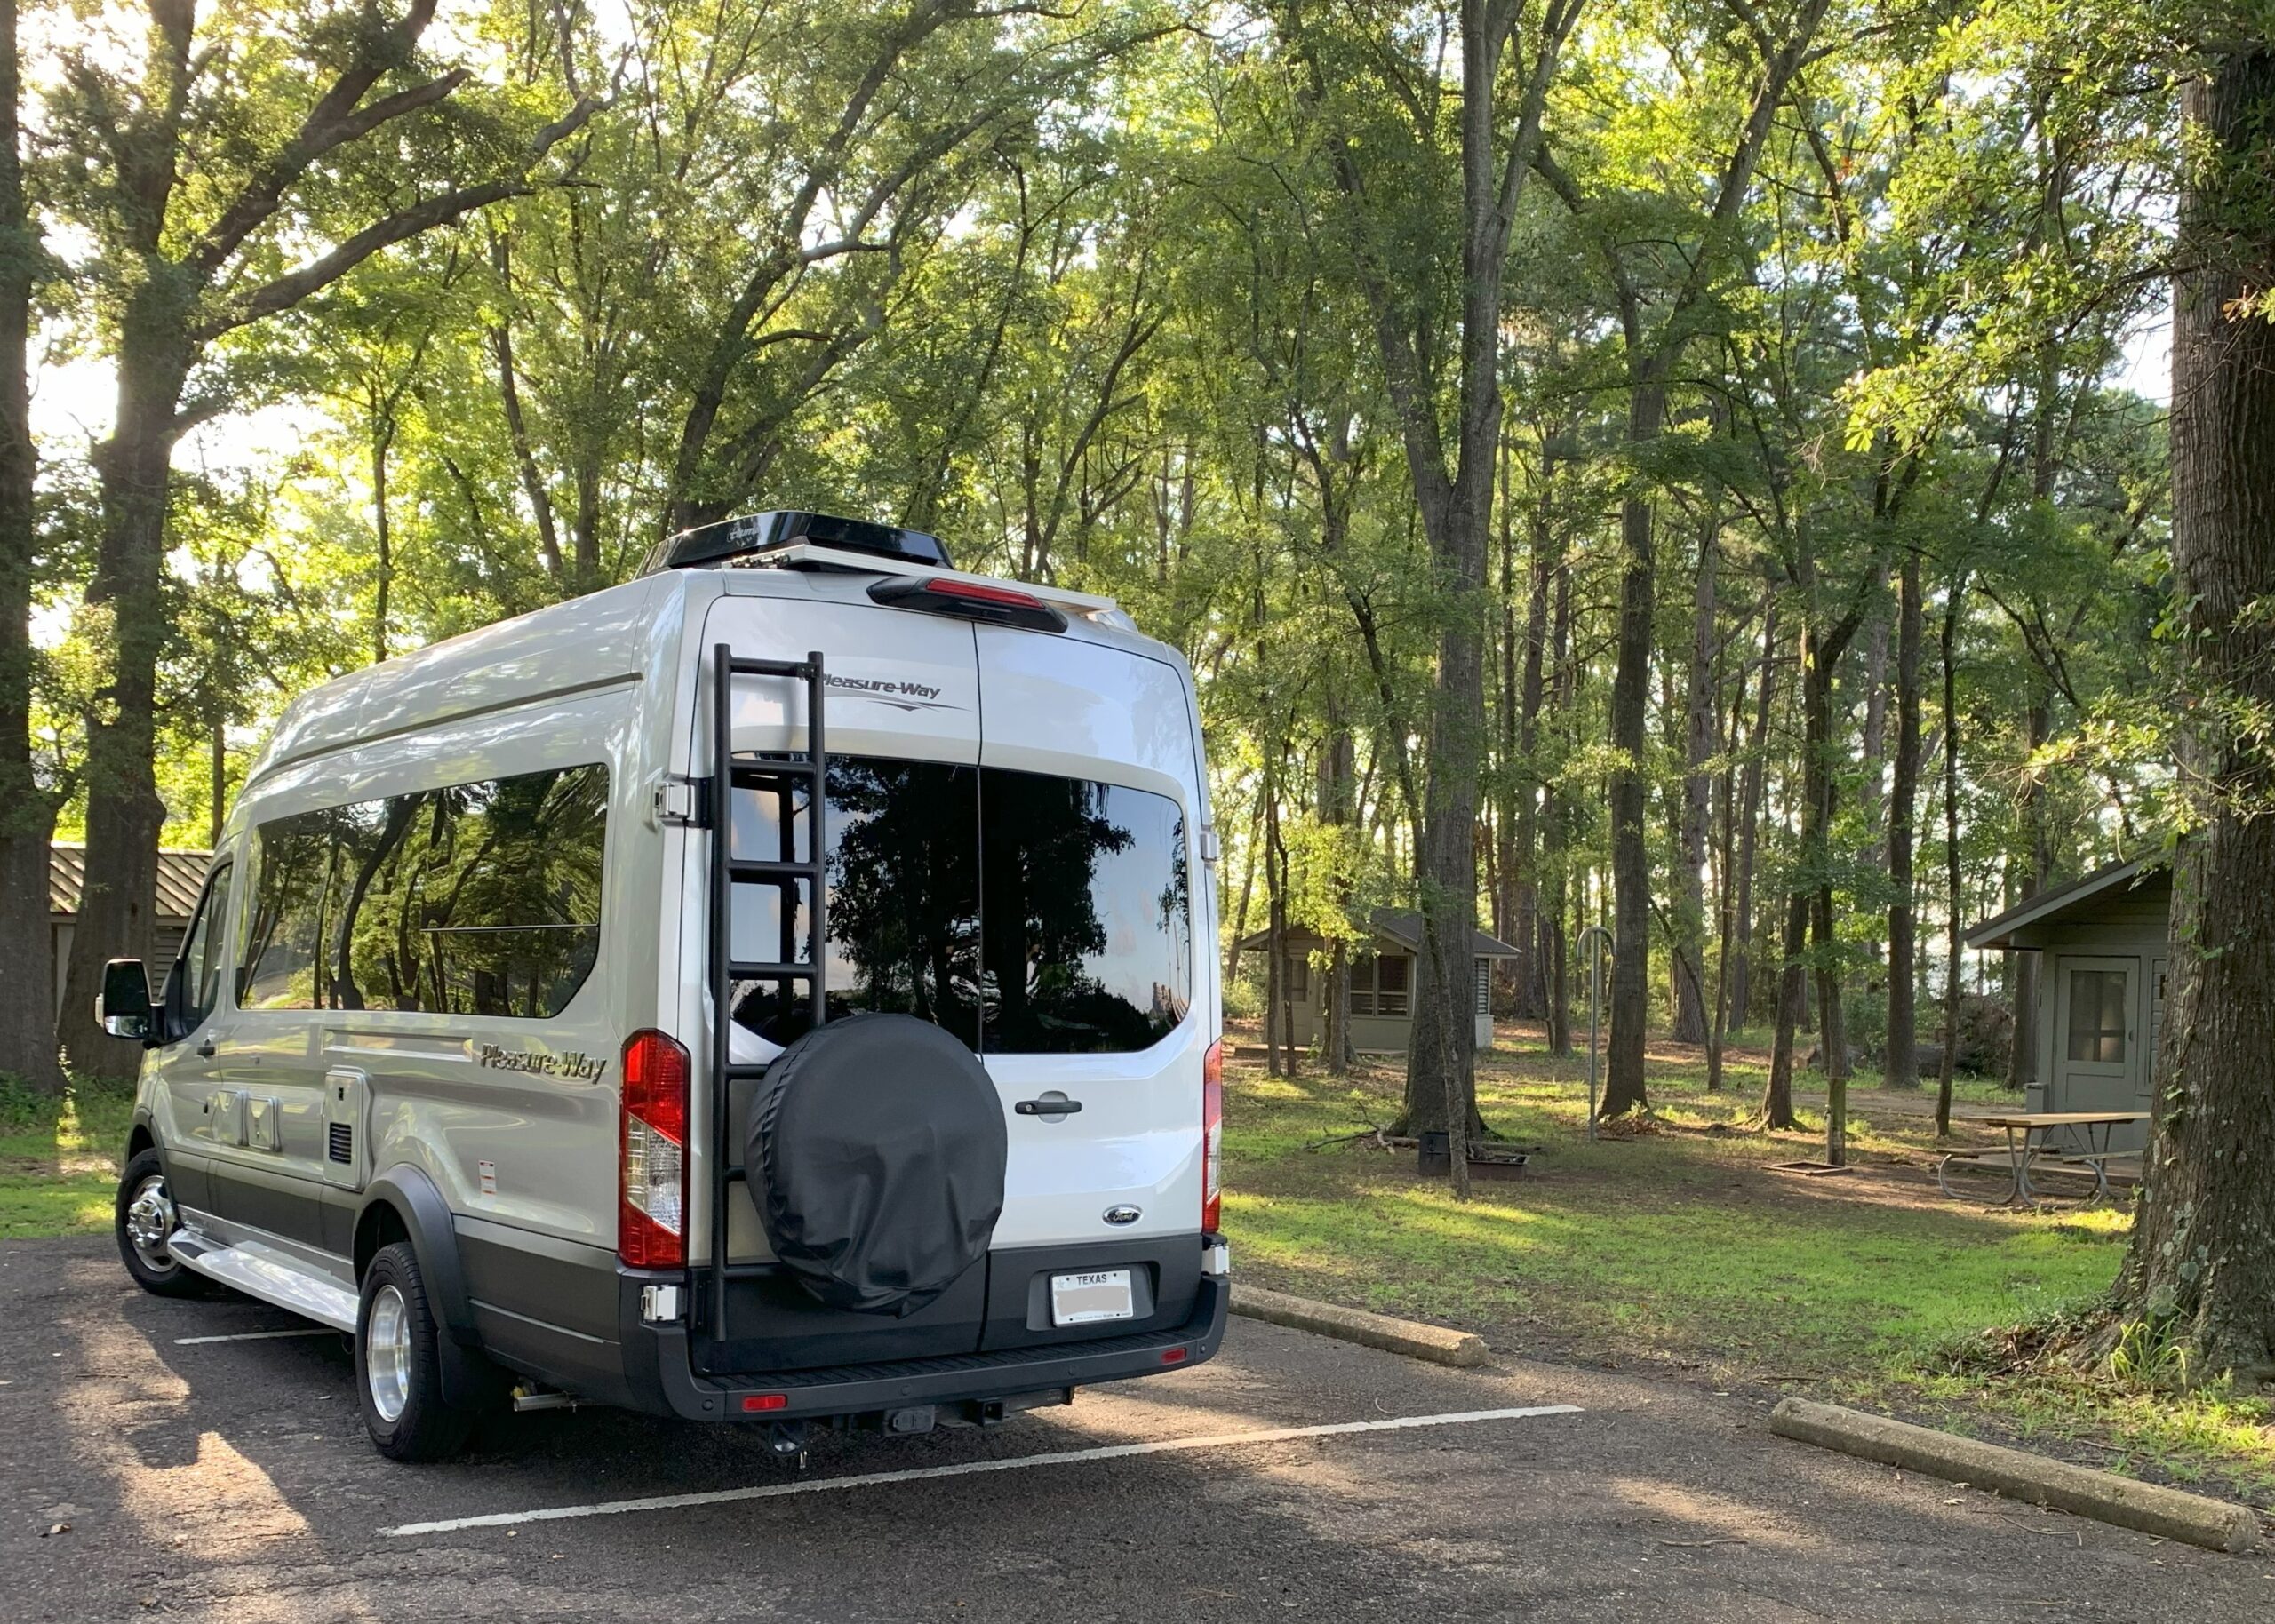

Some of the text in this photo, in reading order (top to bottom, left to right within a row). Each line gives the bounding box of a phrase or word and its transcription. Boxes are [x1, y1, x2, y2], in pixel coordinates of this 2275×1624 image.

[480, 1042, 607, 1085] Pleasure-Way
[1113, 1209, 1134, 1221] Ford
[1076, 1273, 1107, 1286] TEXAS
